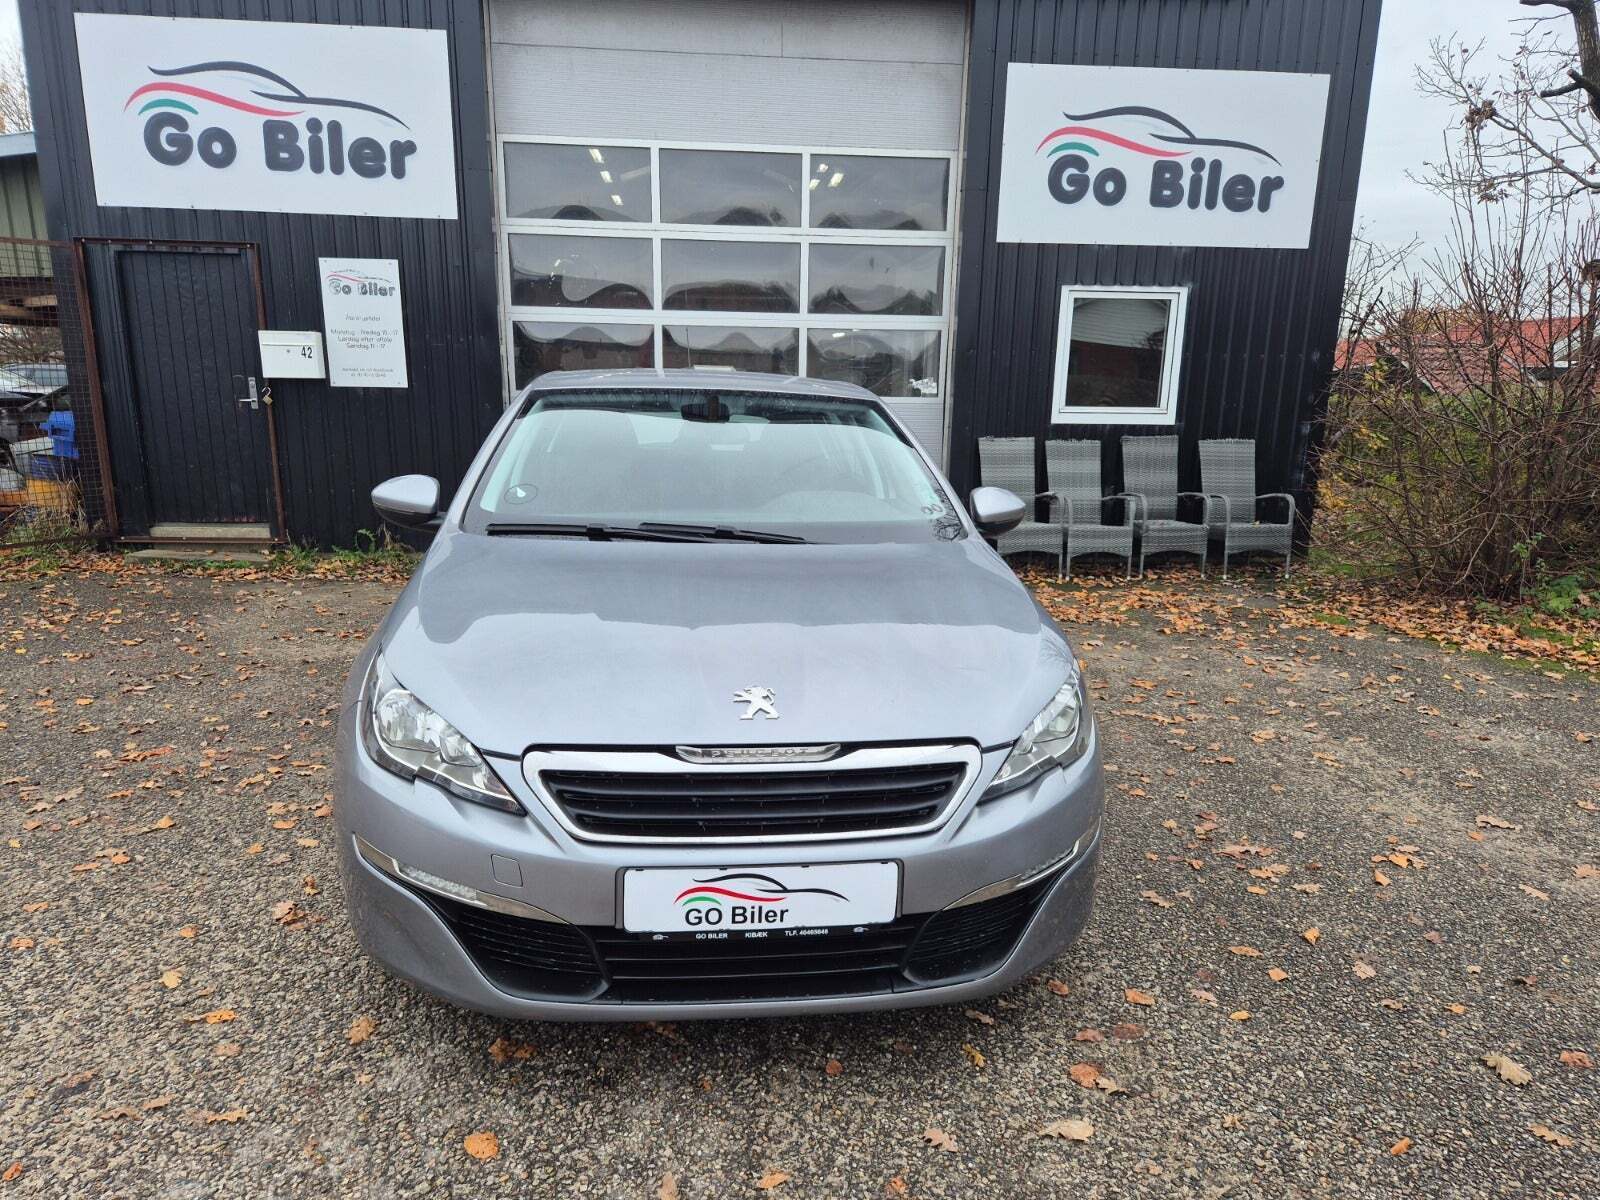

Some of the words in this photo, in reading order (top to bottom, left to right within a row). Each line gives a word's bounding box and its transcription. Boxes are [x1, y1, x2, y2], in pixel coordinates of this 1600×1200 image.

[143, 111, 237, 169] Go
[262, 117, 417, 179] Biler
[1047, 153, 1127, 206] Go
[1149, 157, 1285, 213] Biler
[329, 281, 352, 296] Go
[357, 281, 396, 297] Biler
[301, 346, 313, 359] 42
[684, 907, 723, 926] GO
[731, 905, 789, 925] Biler
[708, 932, 728, 940] BILER
[745, 931, 768, 939] KIBÆK
